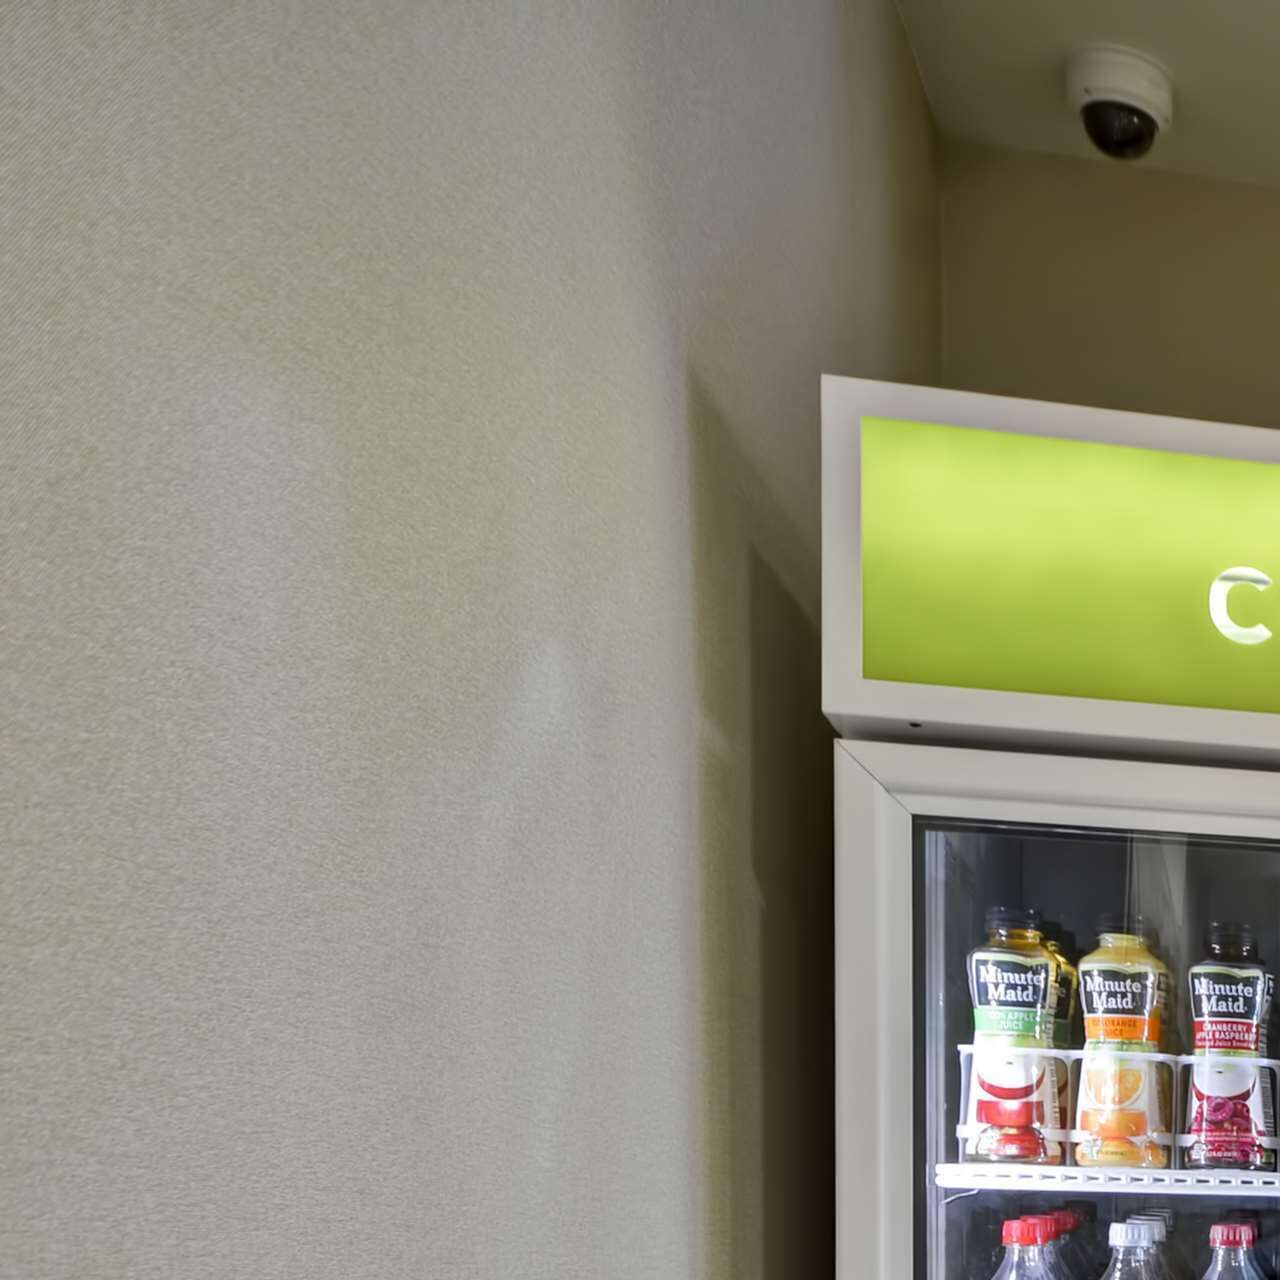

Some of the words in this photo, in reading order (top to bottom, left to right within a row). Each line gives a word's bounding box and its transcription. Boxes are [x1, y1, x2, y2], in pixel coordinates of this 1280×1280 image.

[979, 963, 1041, 985] Minute
[988, 984, 1035, 1002] Maid
[1085, 976, 1142, 993] Minute
[1194, 977, 1253, 997] Minute
[1093, 992, 1134, 1009] Maid
[1202, 995, 1245, 1013] Maid
